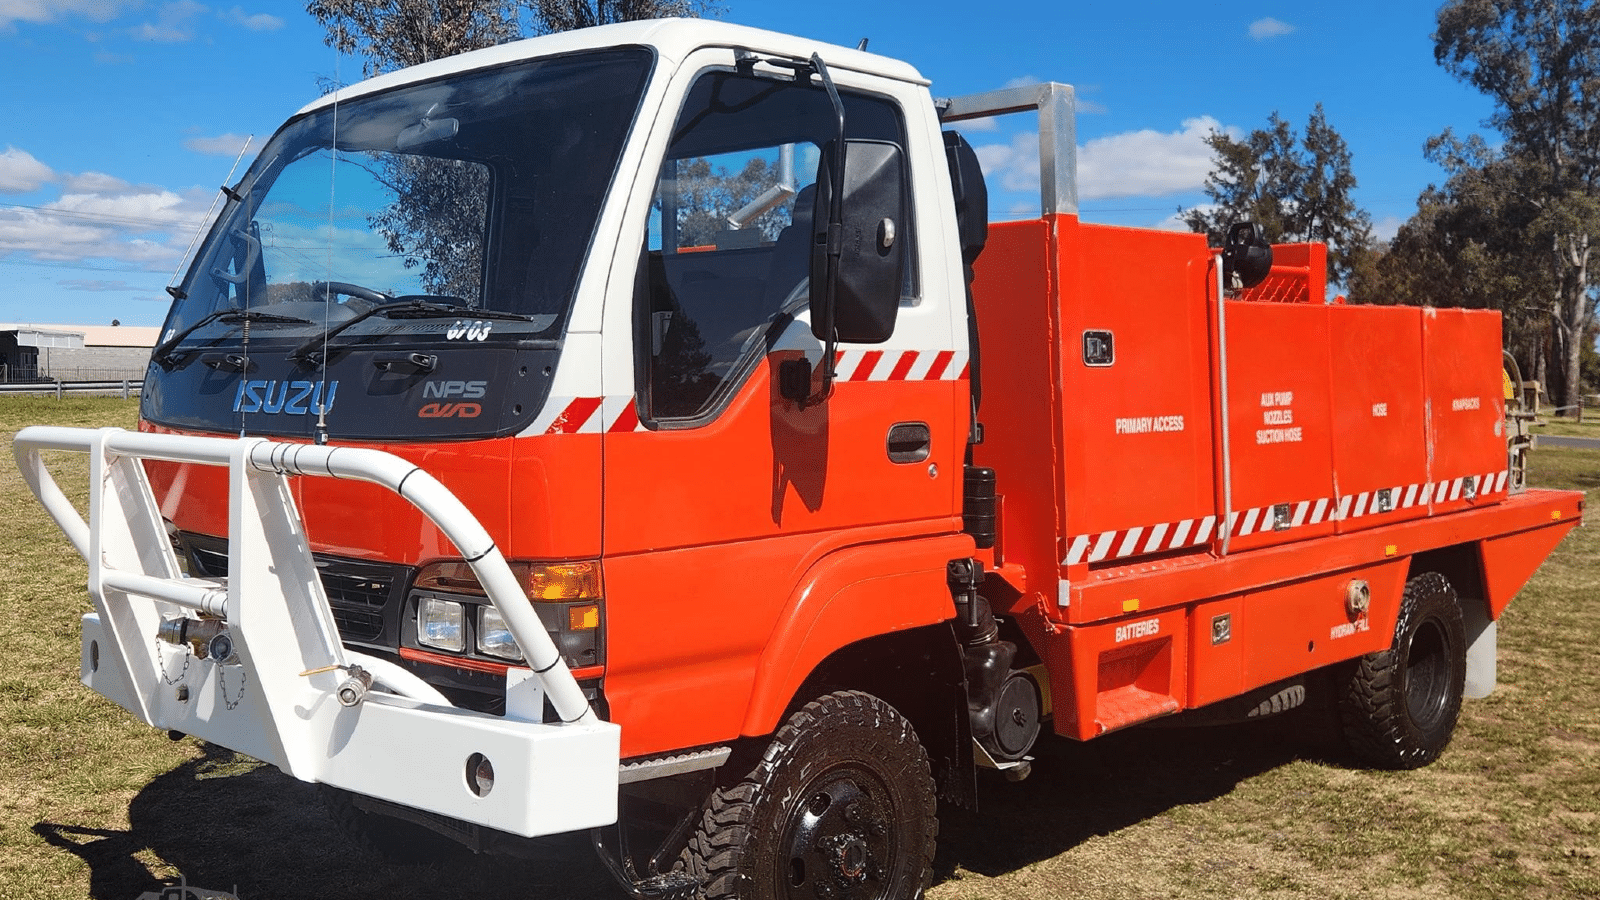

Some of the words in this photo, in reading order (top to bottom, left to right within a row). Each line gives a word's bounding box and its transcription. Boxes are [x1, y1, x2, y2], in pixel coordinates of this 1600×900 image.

[232, 380, 339, 415] ISUZU
[423, 381, 487, 398] NPS
[1274, 391, 1293, 406] PUMP
[1263, 409, 1292, 425] NOZZLES
[1372, 402, 1388, 417] HOSE
[1115, 417, 1152, 434] PRIMARY
[1152, 415, 1184, 432] ACCESS
[1255, 429, 1284, 445] SUCTION
[1284, 427, 1302, 442] HOSE
[1115, 618, 1160, 643] BATTERIES
